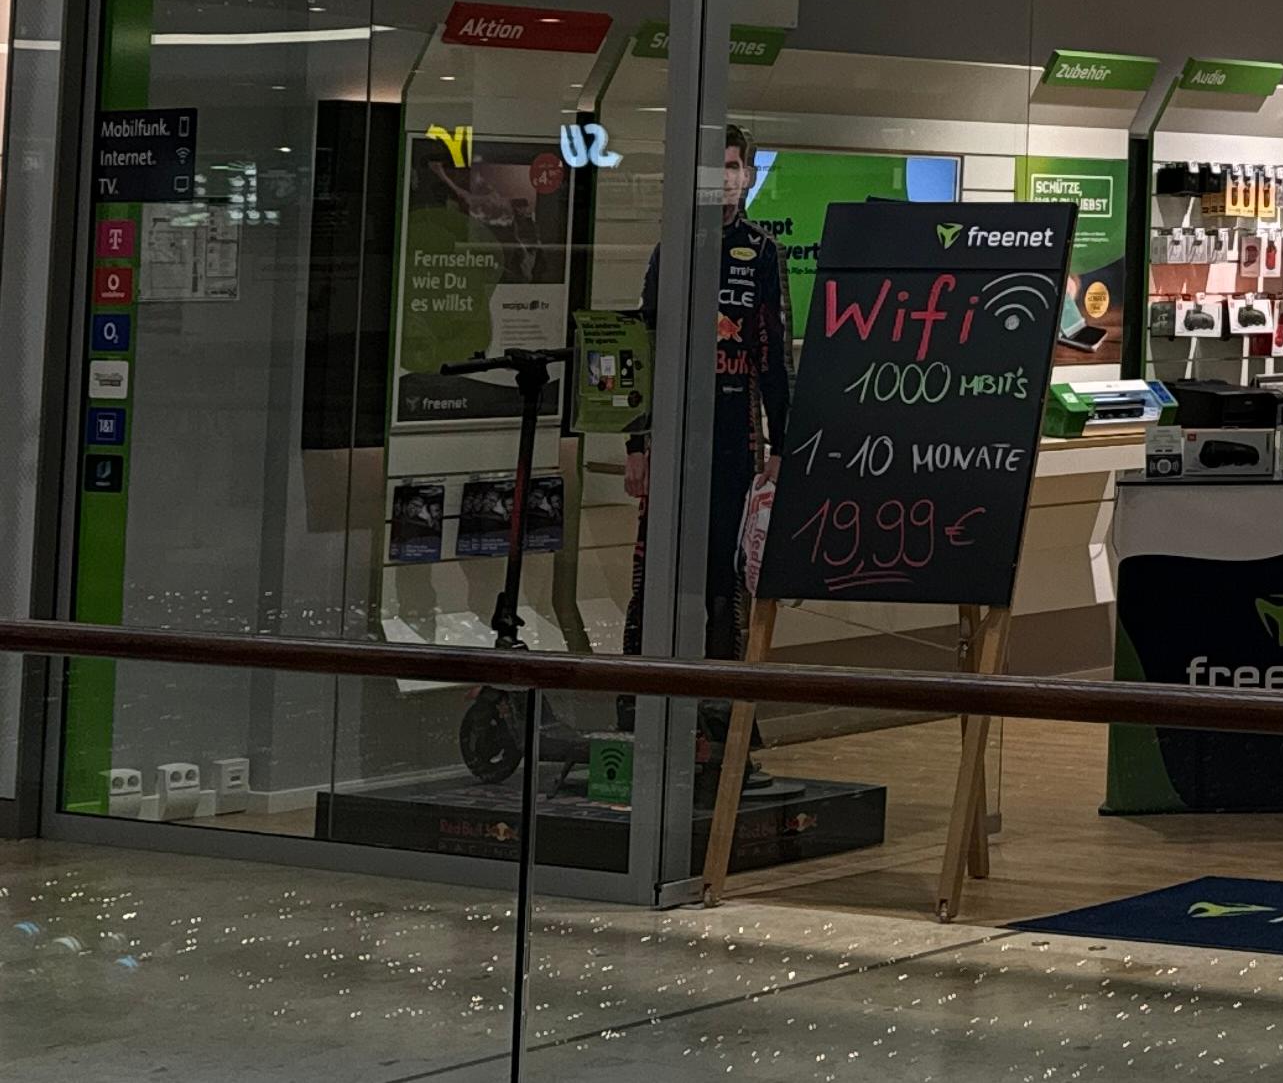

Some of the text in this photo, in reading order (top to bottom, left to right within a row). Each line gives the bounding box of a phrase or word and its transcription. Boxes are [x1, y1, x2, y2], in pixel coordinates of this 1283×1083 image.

[458, 18, 525, 41] Aktion
[1055, 62, 1112, 82] Zubehör
[1190, 68, 1227, 85] Audio
[100, 118, 171, 138] Mobilfunk.
[100, 150, 157, 167] Internet.
[98, 178, 119, 195] TV.
[1035, 179, 1083, 198] SCHÜTZE,
[968, 226, 1054, 247] freenet
[413, 250, 500, 270] Fernsehen,
[411, 273, 468, 290] wie Du
[410, 294, 474, 313] es willst
[718, 288, 756, 308] CLE
[825, 274, 980, 361] Wifi
[844, 361, 951, 404] 1000
[422, 396, 468, 410] freenet
[912, 443, 1027, 474] MONATE
[791, 498, 934, 570] 19,99
